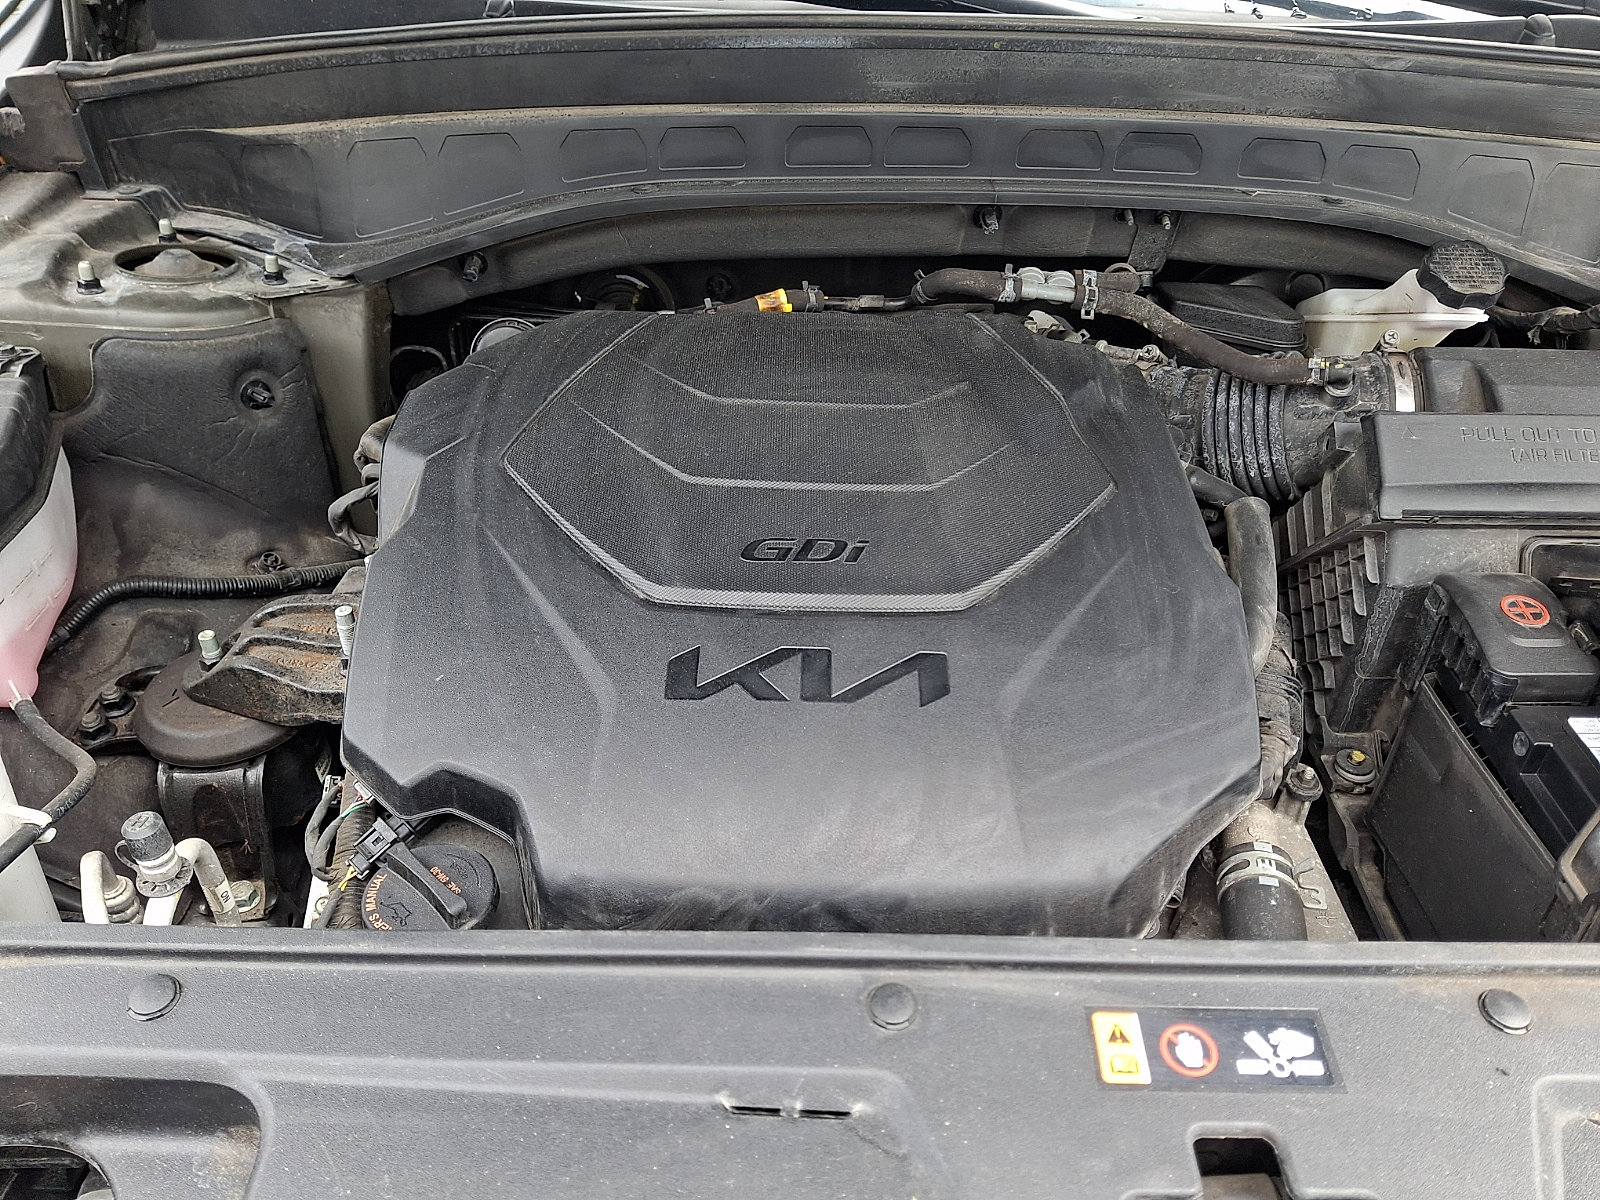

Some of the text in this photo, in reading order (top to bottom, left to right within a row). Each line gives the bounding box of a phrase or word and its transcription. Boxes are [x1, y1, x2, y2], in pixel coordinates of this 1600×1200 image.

[1460, 426, 1597, 444] PULL OUT TO
[740, 538, 869, 564] GDi
[664, 644, 950, 707] KIA
[447, 881, 462, 895] SAE
[365, 873, 393, 930] ER'S MANUAL
